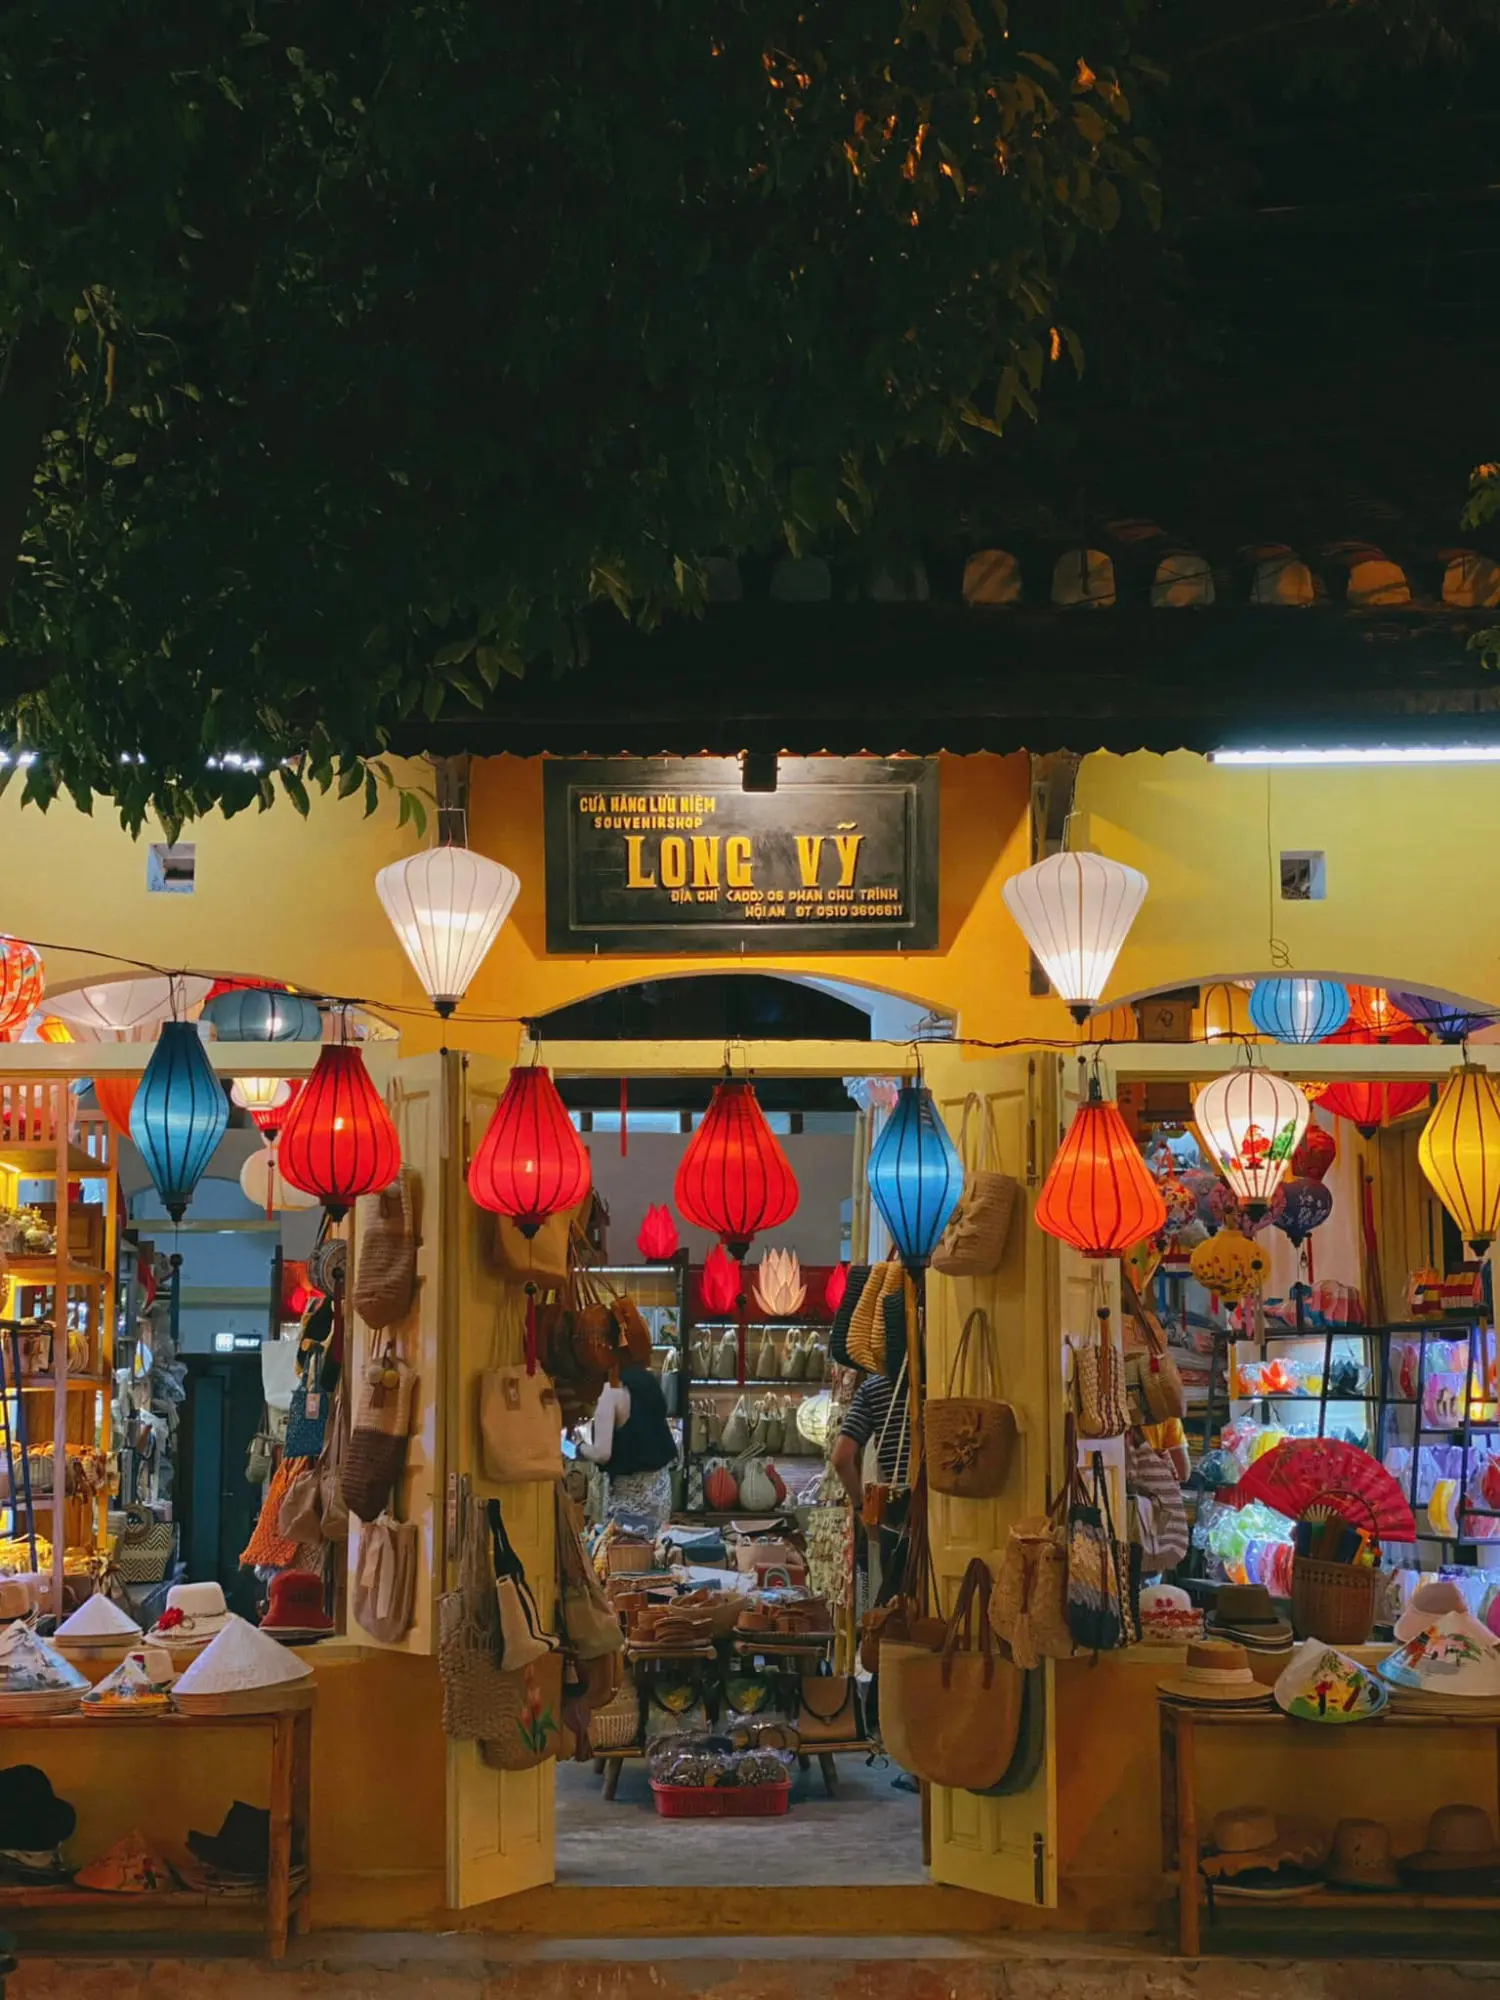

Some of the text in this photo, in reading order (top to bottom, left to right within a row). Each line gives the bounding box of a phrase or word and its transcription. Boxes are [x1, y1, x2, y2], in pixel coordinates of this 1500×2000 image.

[624, 822, 864, 888] LONG VỸ
[788, 889, 823, 902] PHAN
[816, 905, 848, 917] 0510
